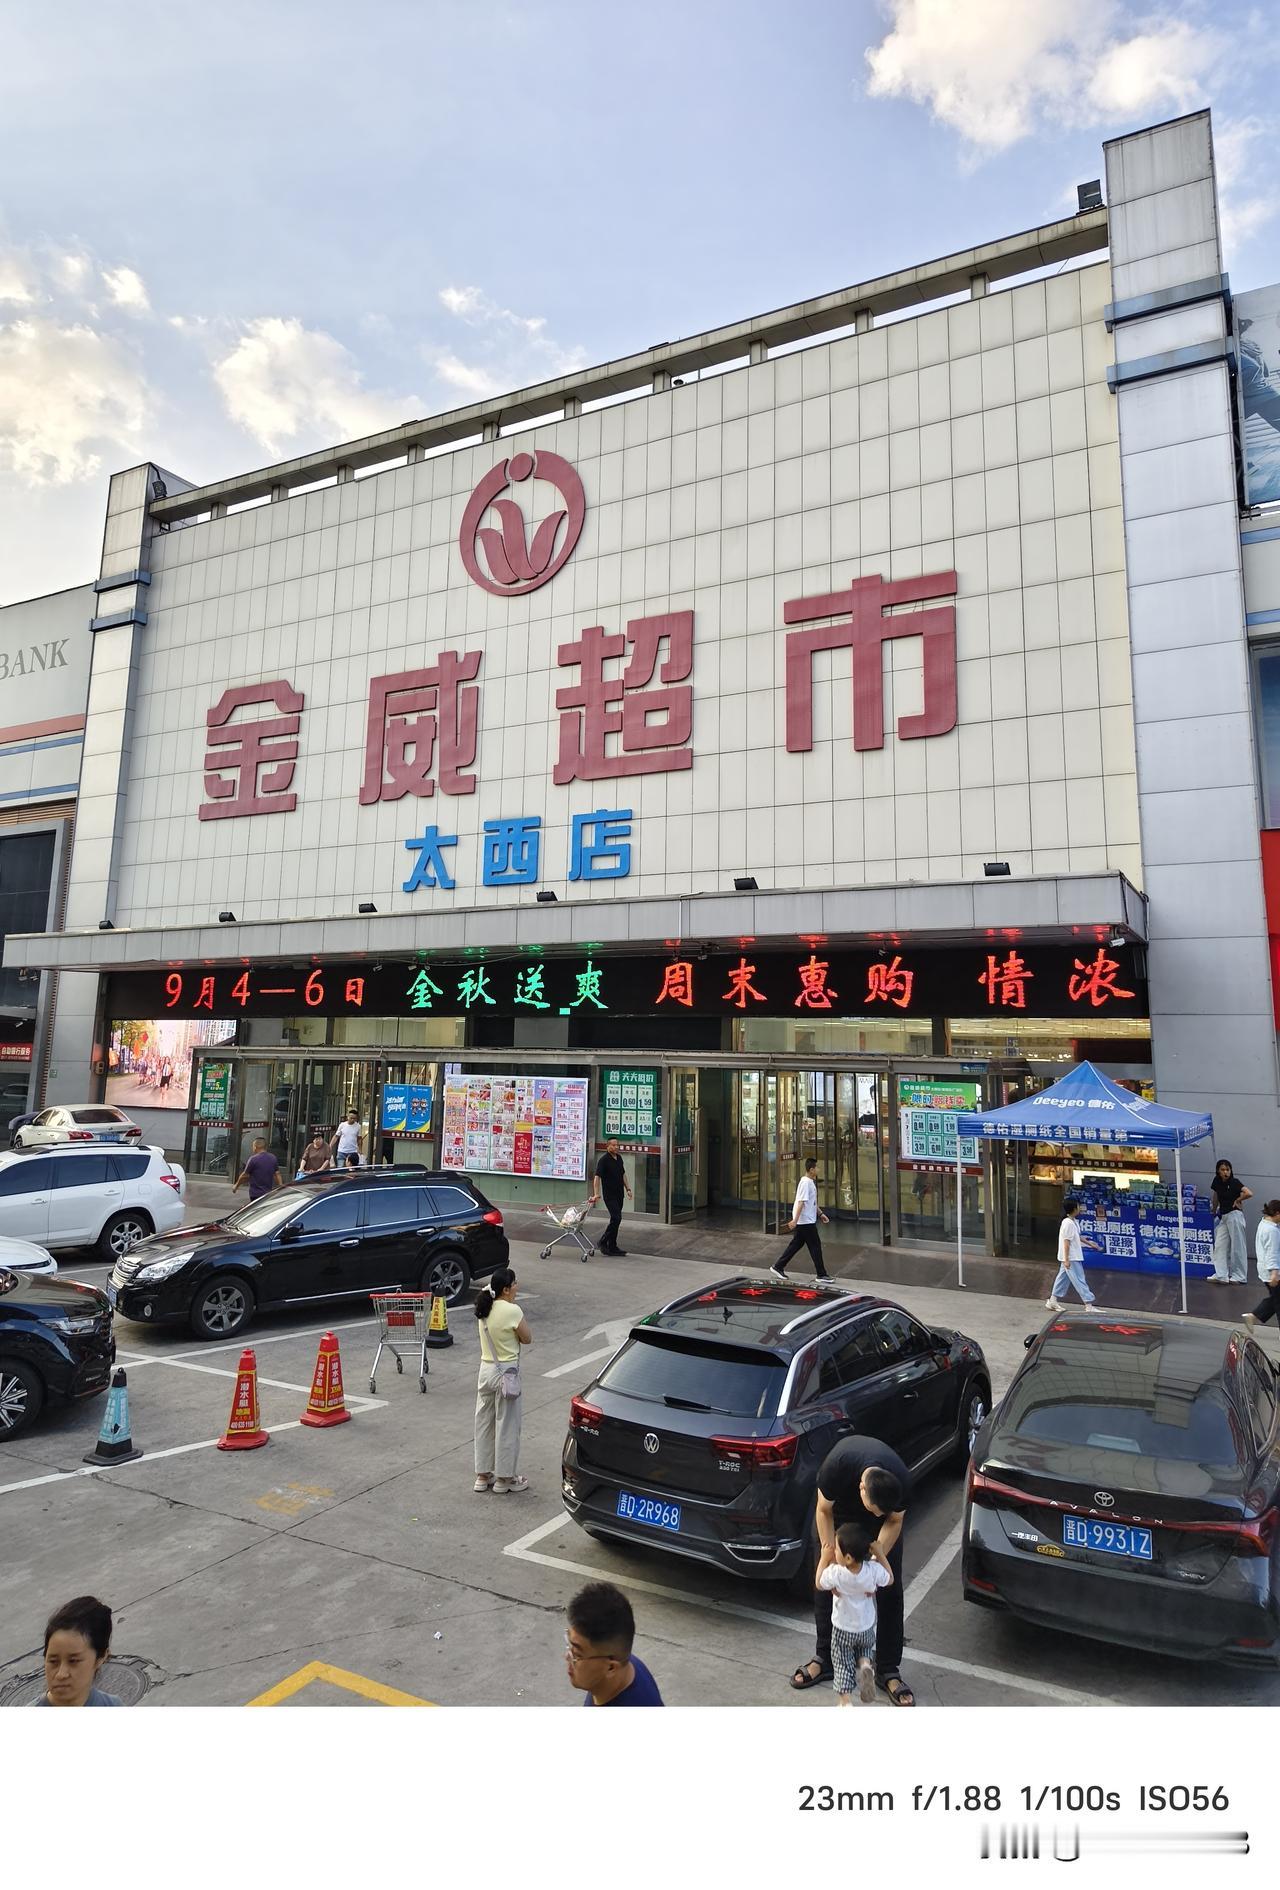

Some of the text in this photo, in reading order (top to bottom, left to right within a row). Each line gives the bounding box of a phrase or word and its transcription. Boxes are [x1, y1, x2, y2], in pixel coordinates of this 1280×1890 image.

[0, 638, 70, 680] BANK
[198, 570, 958, 821] 金威超市
[402, 809, 634, 893] 太西店
[406, 961, 609, 1009] 金秋送爽
[656, 955, 914, 1009] 周末惠购
[978, 948, 1136, 1008] 情浓
[1033, 1097, 1085, 1108] Deeyeo
[982, 1122, 1144, 1142] 德佑湿厕纸全国销量第一
[1077, 1219, 1136, 1236] 佑湿厕纸
[1109, 1236, 1133, 1248] 湿擦
[1185, 1242, 1211, 1255] 湿擦
[1109, 1247, 1134, 1256] 更干净
[1185, 1254, 1212, 1264] 更干净
[1050, 1500, 1163, 1524] AVALON
